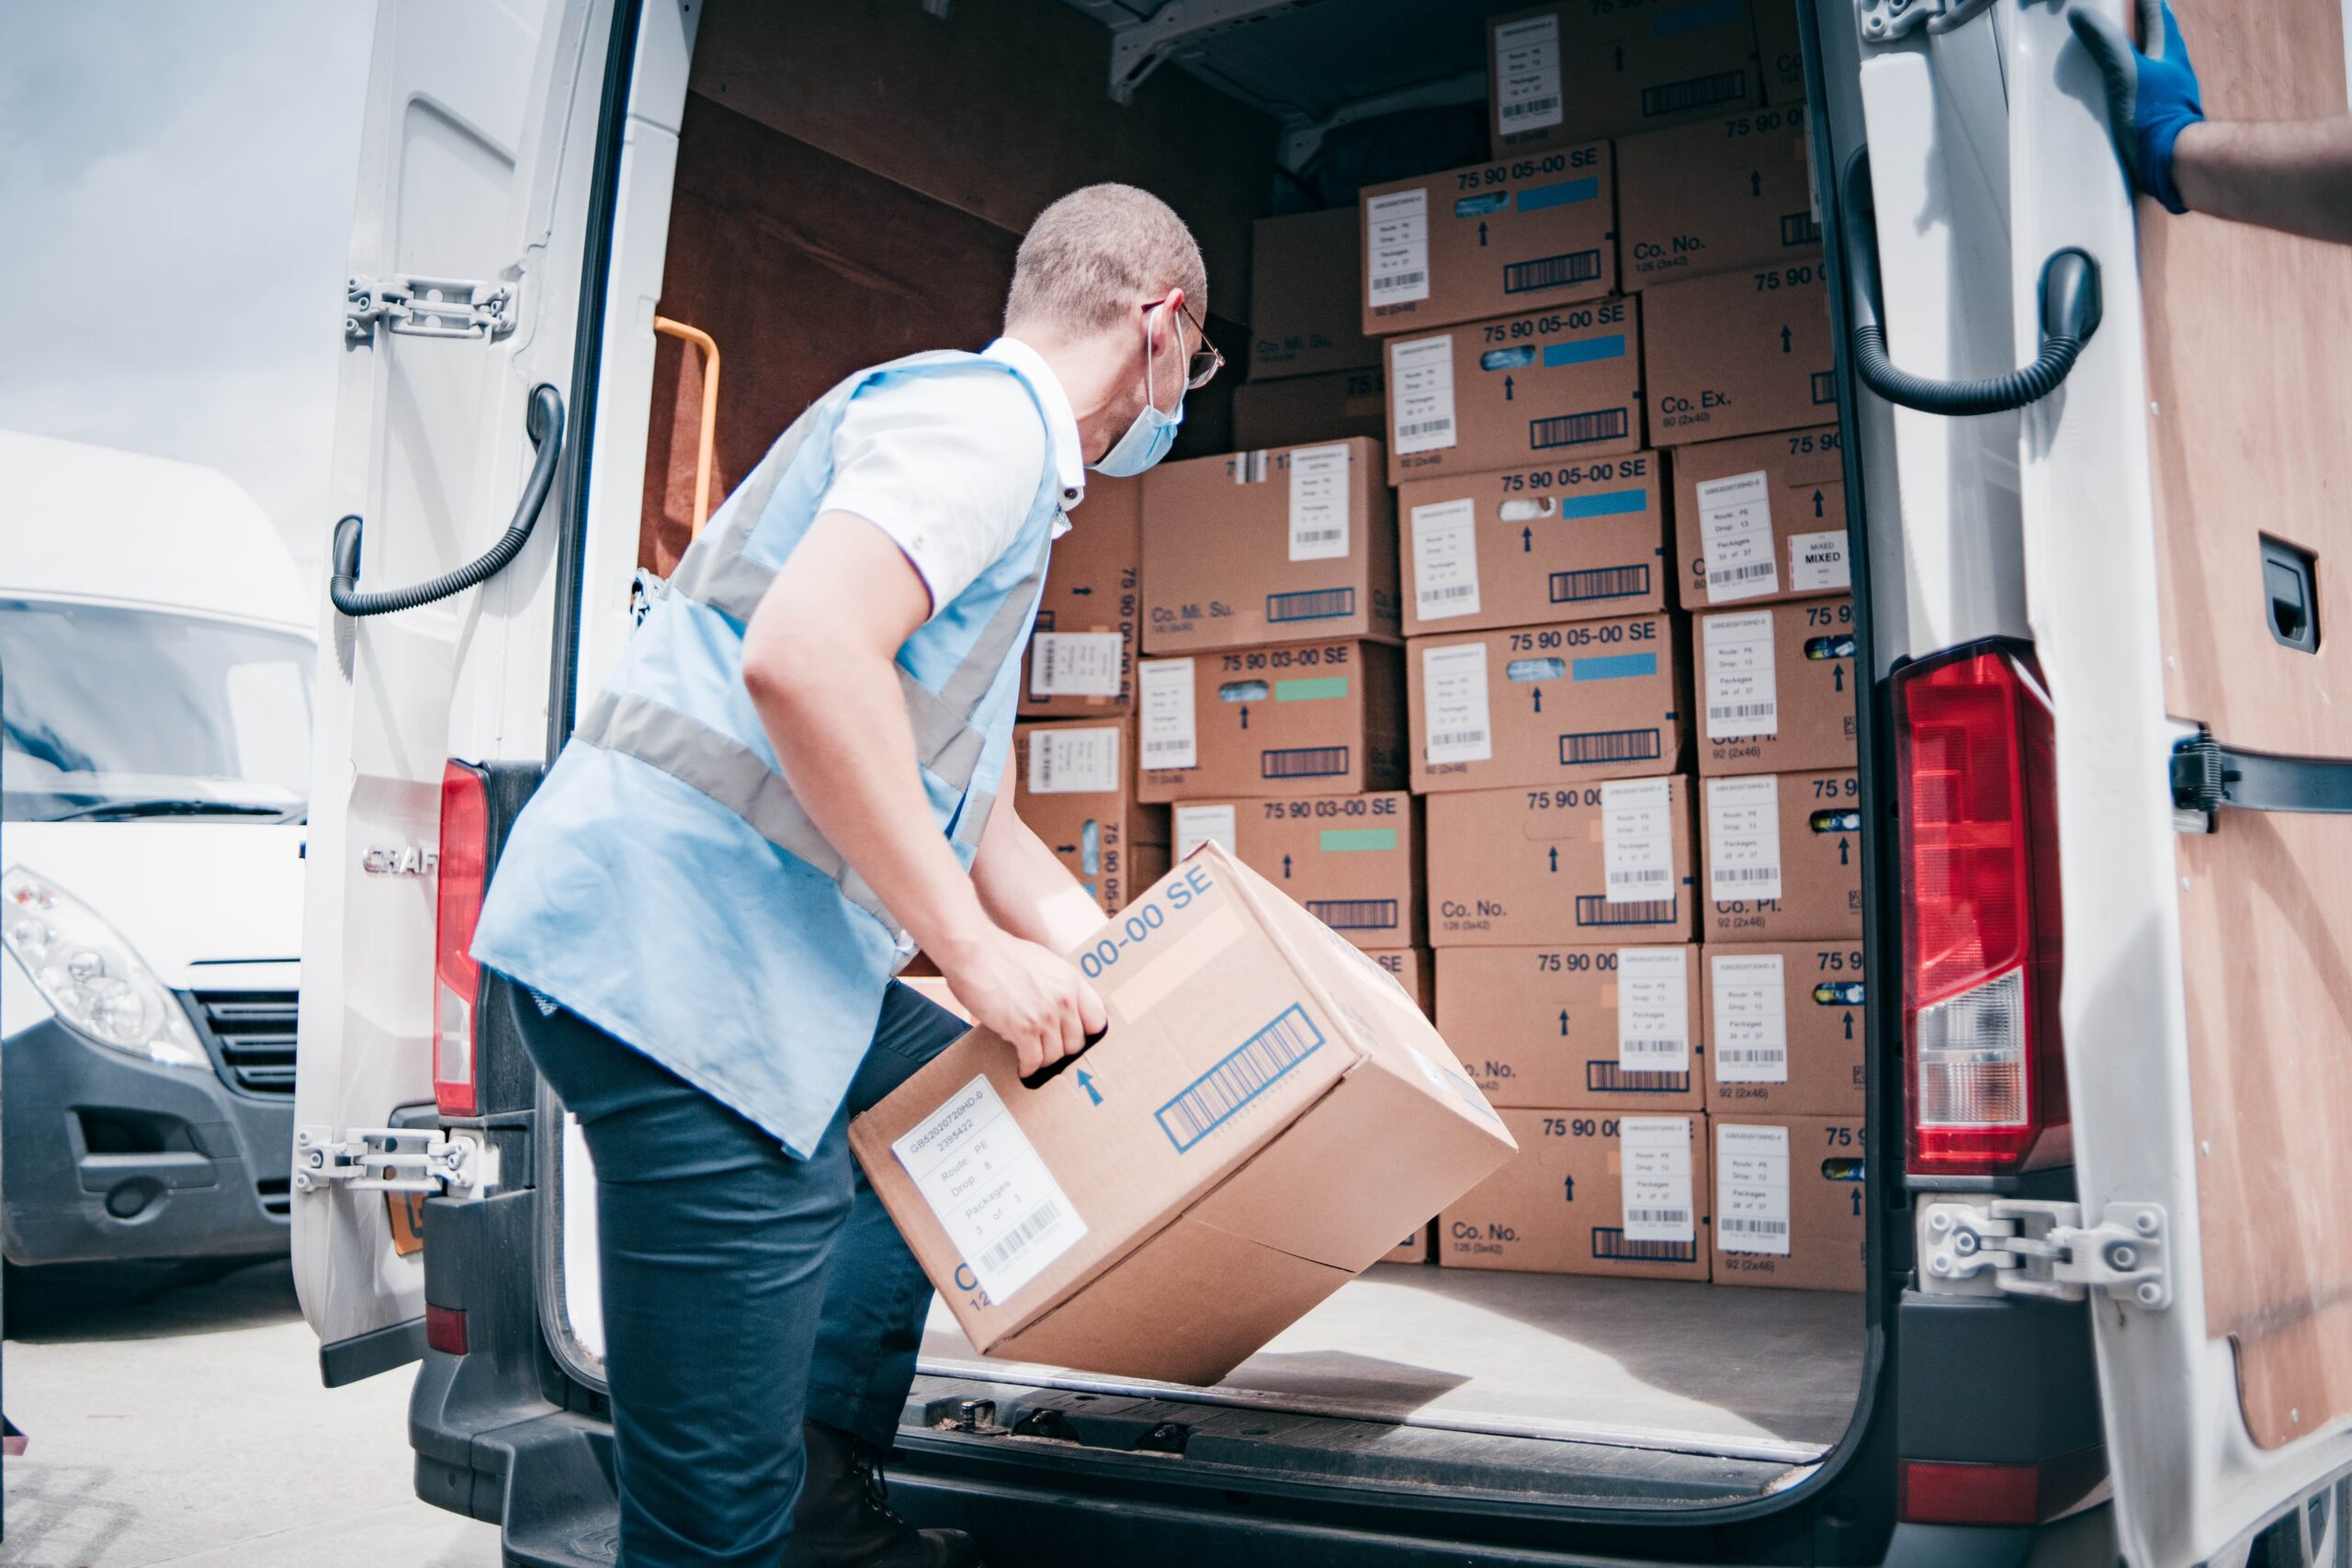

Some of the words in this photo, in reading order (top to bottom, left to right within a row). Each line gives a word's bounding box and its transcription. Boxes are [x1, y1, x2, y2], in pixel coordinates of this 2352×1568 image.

[1724, 118, 1750, 139] 75
[1755, 112, 1781, 133] 90
[1457, 173, 1480, 190] 75
[1484, 166, 1506, 184] 90
[1512, 154, 1566, 179] 05-00
[1571, 148, 1598, 166] SE
[1634, 243, 1667, 259] Co.
[1672, 234, 1706, 254] No.
[1754, 272, 1781, 292] 75
[1785, 265, 1812, 287] 90
[1483, 325, 1506, 344] 75
[1510, 321, 1533, 339] 90
[1539, 310, 1592, 335] 05-00
[1598, 305, 1624, 323] SE
[1661, 397, 1695, 414] Co.
[1702, 389, 1732, 409] Ex.
[1788, 436, 1814, 456] 75
[1501, 475, 1525, 492] 75
[1529, 471, 1553, 490] 90
[1558, 463, 1613, 486] 05-00
[1619, 459, 1646, 478] SE
[1716, 537, 1750, 548] Packages
[1809, 542, 1835, 551] MIXED
[1804, 551, 1841, 564] MIXED
[1807, 607, 1832, 626] 75
[1510, 634, 1533, 651] 75
[1539, 632, 1562, 650] 90
[1567, 625, 1623, 647] 05-00
[1628, 622, 1657, 640] SE
[1222, 654, 1243, 671] 75
[1247, 652, 1267, 670] 90
[1271, 649, 1319, 668] 03-00
[1324, 647, 1349, 664] SE
[1720, 676, 1753, 684] Packages
[1813, 780, 1838, 797] 75
[1264, 802, 1285, 819] 75
[1289, 800, 1312, 818] 90
[1315, 798, 1367, 818] 03-00
[1372, 797, 1396, 815] SE
[1527, 791, 1551, 809] 75
[1555, 789, 1579, 808] 90
[1441, 900, 1472, 918] Co.
[1476, 899, 1508, 917] No.
[1080, 902, 1164, 979] 00-00
[1165, 863, 1214, 910] SE
[1538, 954, 1562, 972] 75
[1566, 953, 1590, 972] 90
[1818, 952, 1844, 971] 75
[1729, 1021, 1763, 1029] Packages
[1485, 1060, 1517, 1077] No.
[910, 1089, 984, 1156] GB52020720HD-0
[1544, 1119, 1566, 1136] 75
[1572, 1119, 1596, 1137] 90
[937, 1119, 975, 1153] 2395422
[1825, 1127, 1852, 1146] 75
[941, 1155, 970, 1182] Route:
[974, 1140, 989, 1156] PE
[983, 1161, 992, 1171] 8
[965, 1179, 1012, 1220] Packages
[976, 1225, 984, 1236] 3
[993, 1207, 1003, 1221] of
[1013, 1194, 1022, 1205] 3
[1453, 1222, 1483, 1240] Co.
[1488, 1223, 1521, 1242] No.
